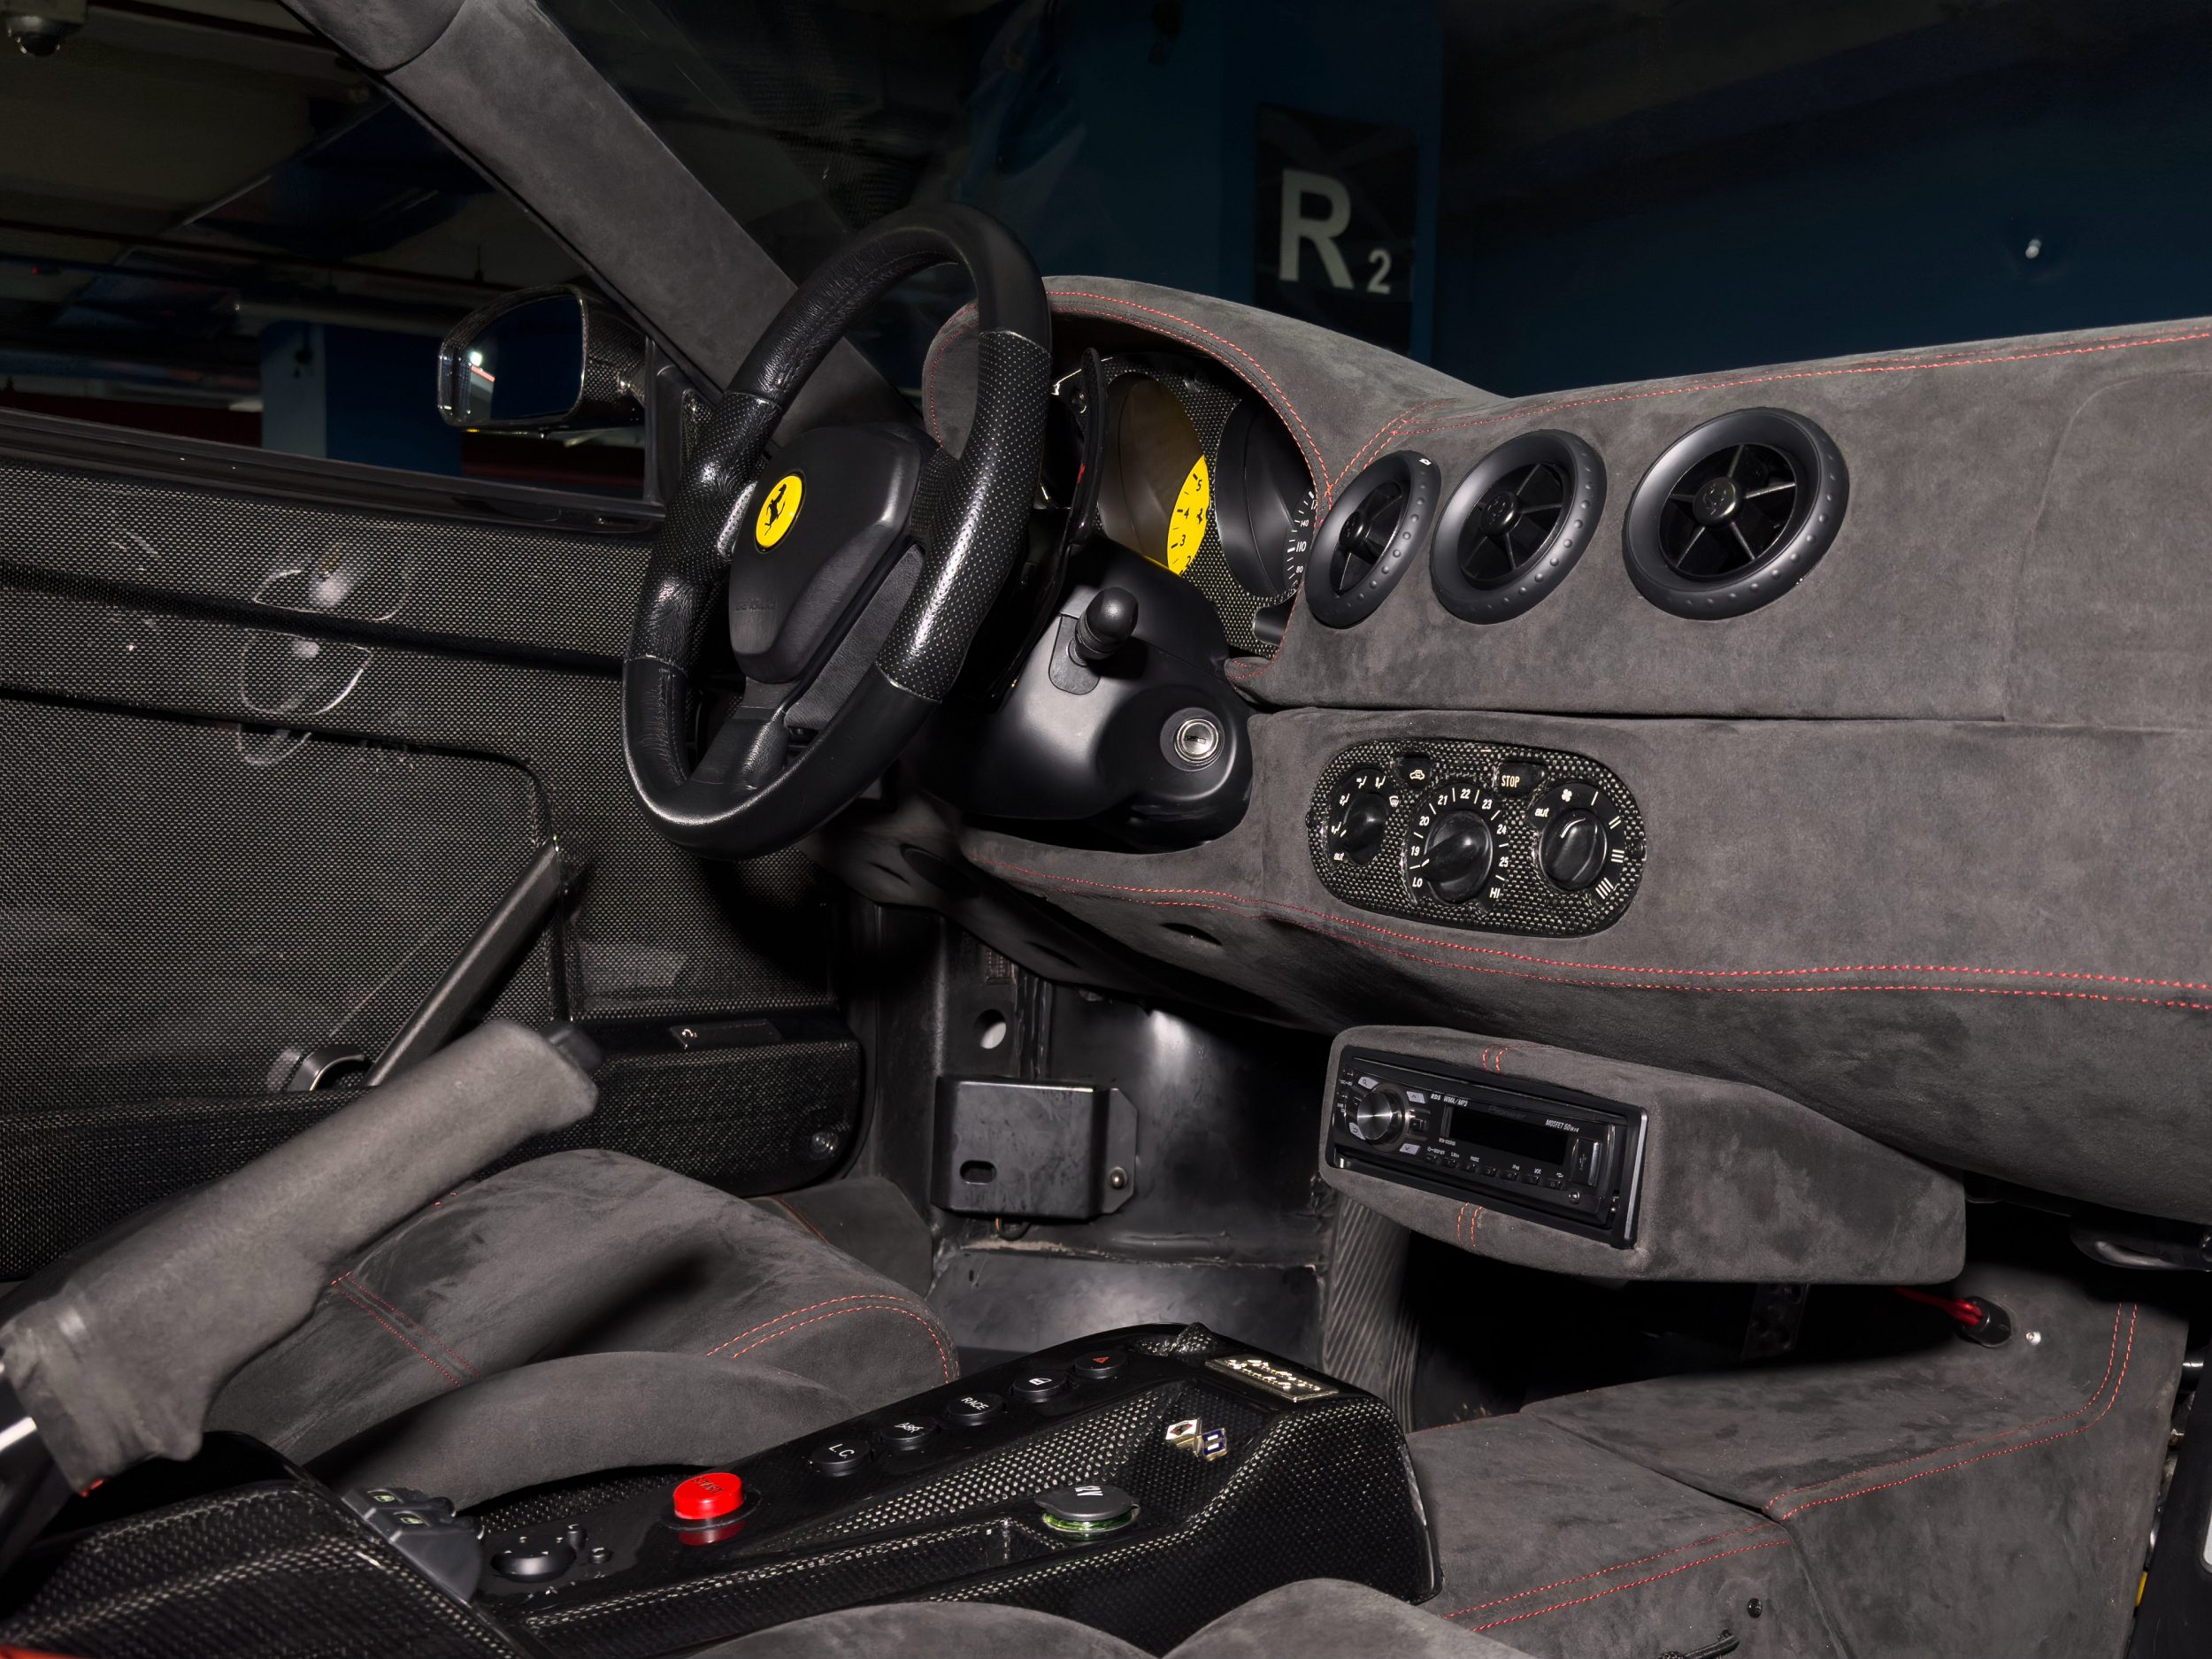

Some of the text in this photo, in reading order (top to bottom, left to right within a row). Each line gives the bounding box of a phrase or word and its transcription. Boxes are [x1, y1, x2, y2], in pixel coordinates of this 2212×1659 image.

[1195, 479, 1202, 491] 5
[1184, 508, 1190, 519] 4
[1179, 534, 1187, 547] 3
[1295, 541, 1307, 553] 110
[1501, 774, 1520, 788] STOP
[1460, 788, 1471, 799] 22
[1438, 795, 1448, 806] 21
[1482, 799, 1493, 810] 23
[1418, 816, 1430, 826] 20
[1496, 824, 1508, 834] 24
[1410, 845, 1420, 856] 19
[1499, 856, 1509, 867] 25
[1412, 877, 1423, 887] LO
[1489, 887, 1501, 899] HI
[961, 1396, 989, 1410] RACE
